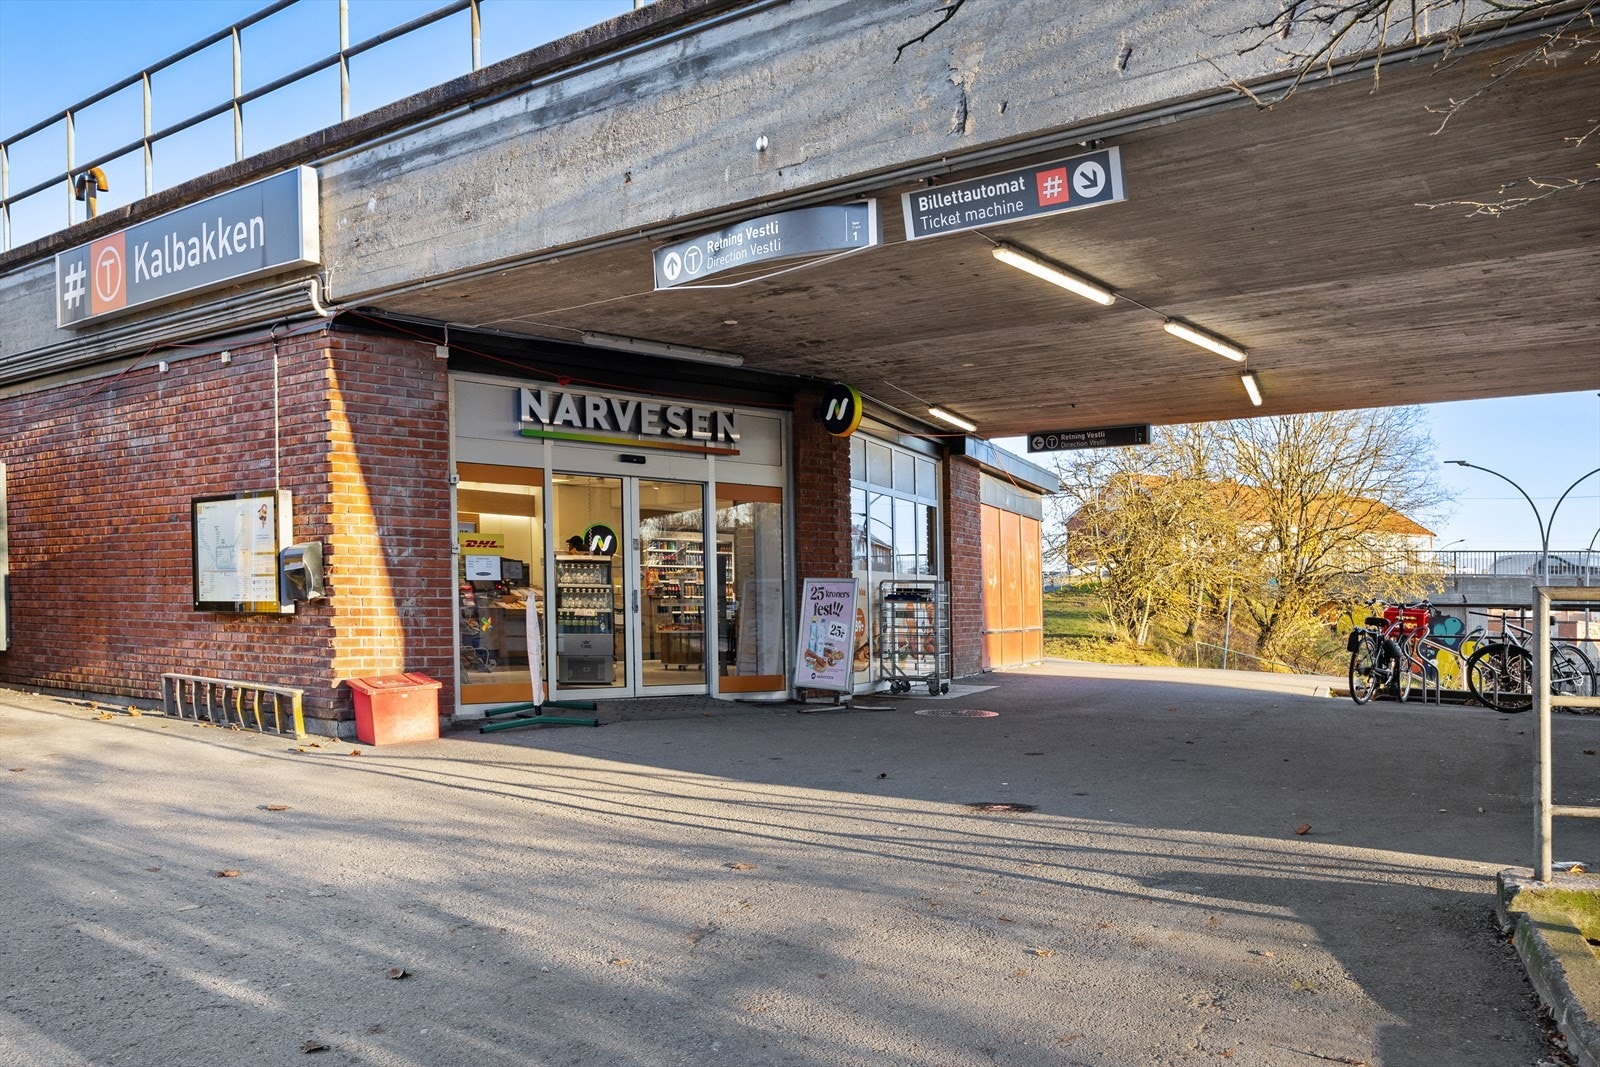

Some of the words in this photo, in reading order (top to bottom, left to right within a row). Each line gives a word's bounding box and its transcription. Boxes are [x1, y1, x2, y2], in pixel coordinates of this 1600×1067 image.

[918, 176, 1026, 212] Billettautomat
[920, 210, 961, 230] Ticket
[965, 199, 1024, 222] machine
[134, 215, 265, 284] Kalbakken
[707, 232, 743, 253] Retning
[746, 220, 779, 240] Vestli
[707, 248, 748, 270] Direction
[750, 238, 781, 256] Vestli
[519, 387, 741, 443] NARVESEN
[1060, 431, 1086, 441] Retning
[1086, 430, 1106, 439] Vestli
[1060, 439, 1089, 449] Direction
[1089, 438, 1107, 447] Vestli
[465, 540, 498, 549] DHL
[810, 586, 825, 601] 25
[825, 589, 850, 599] kroners
[813, 601, 844, 617] fest!!!
